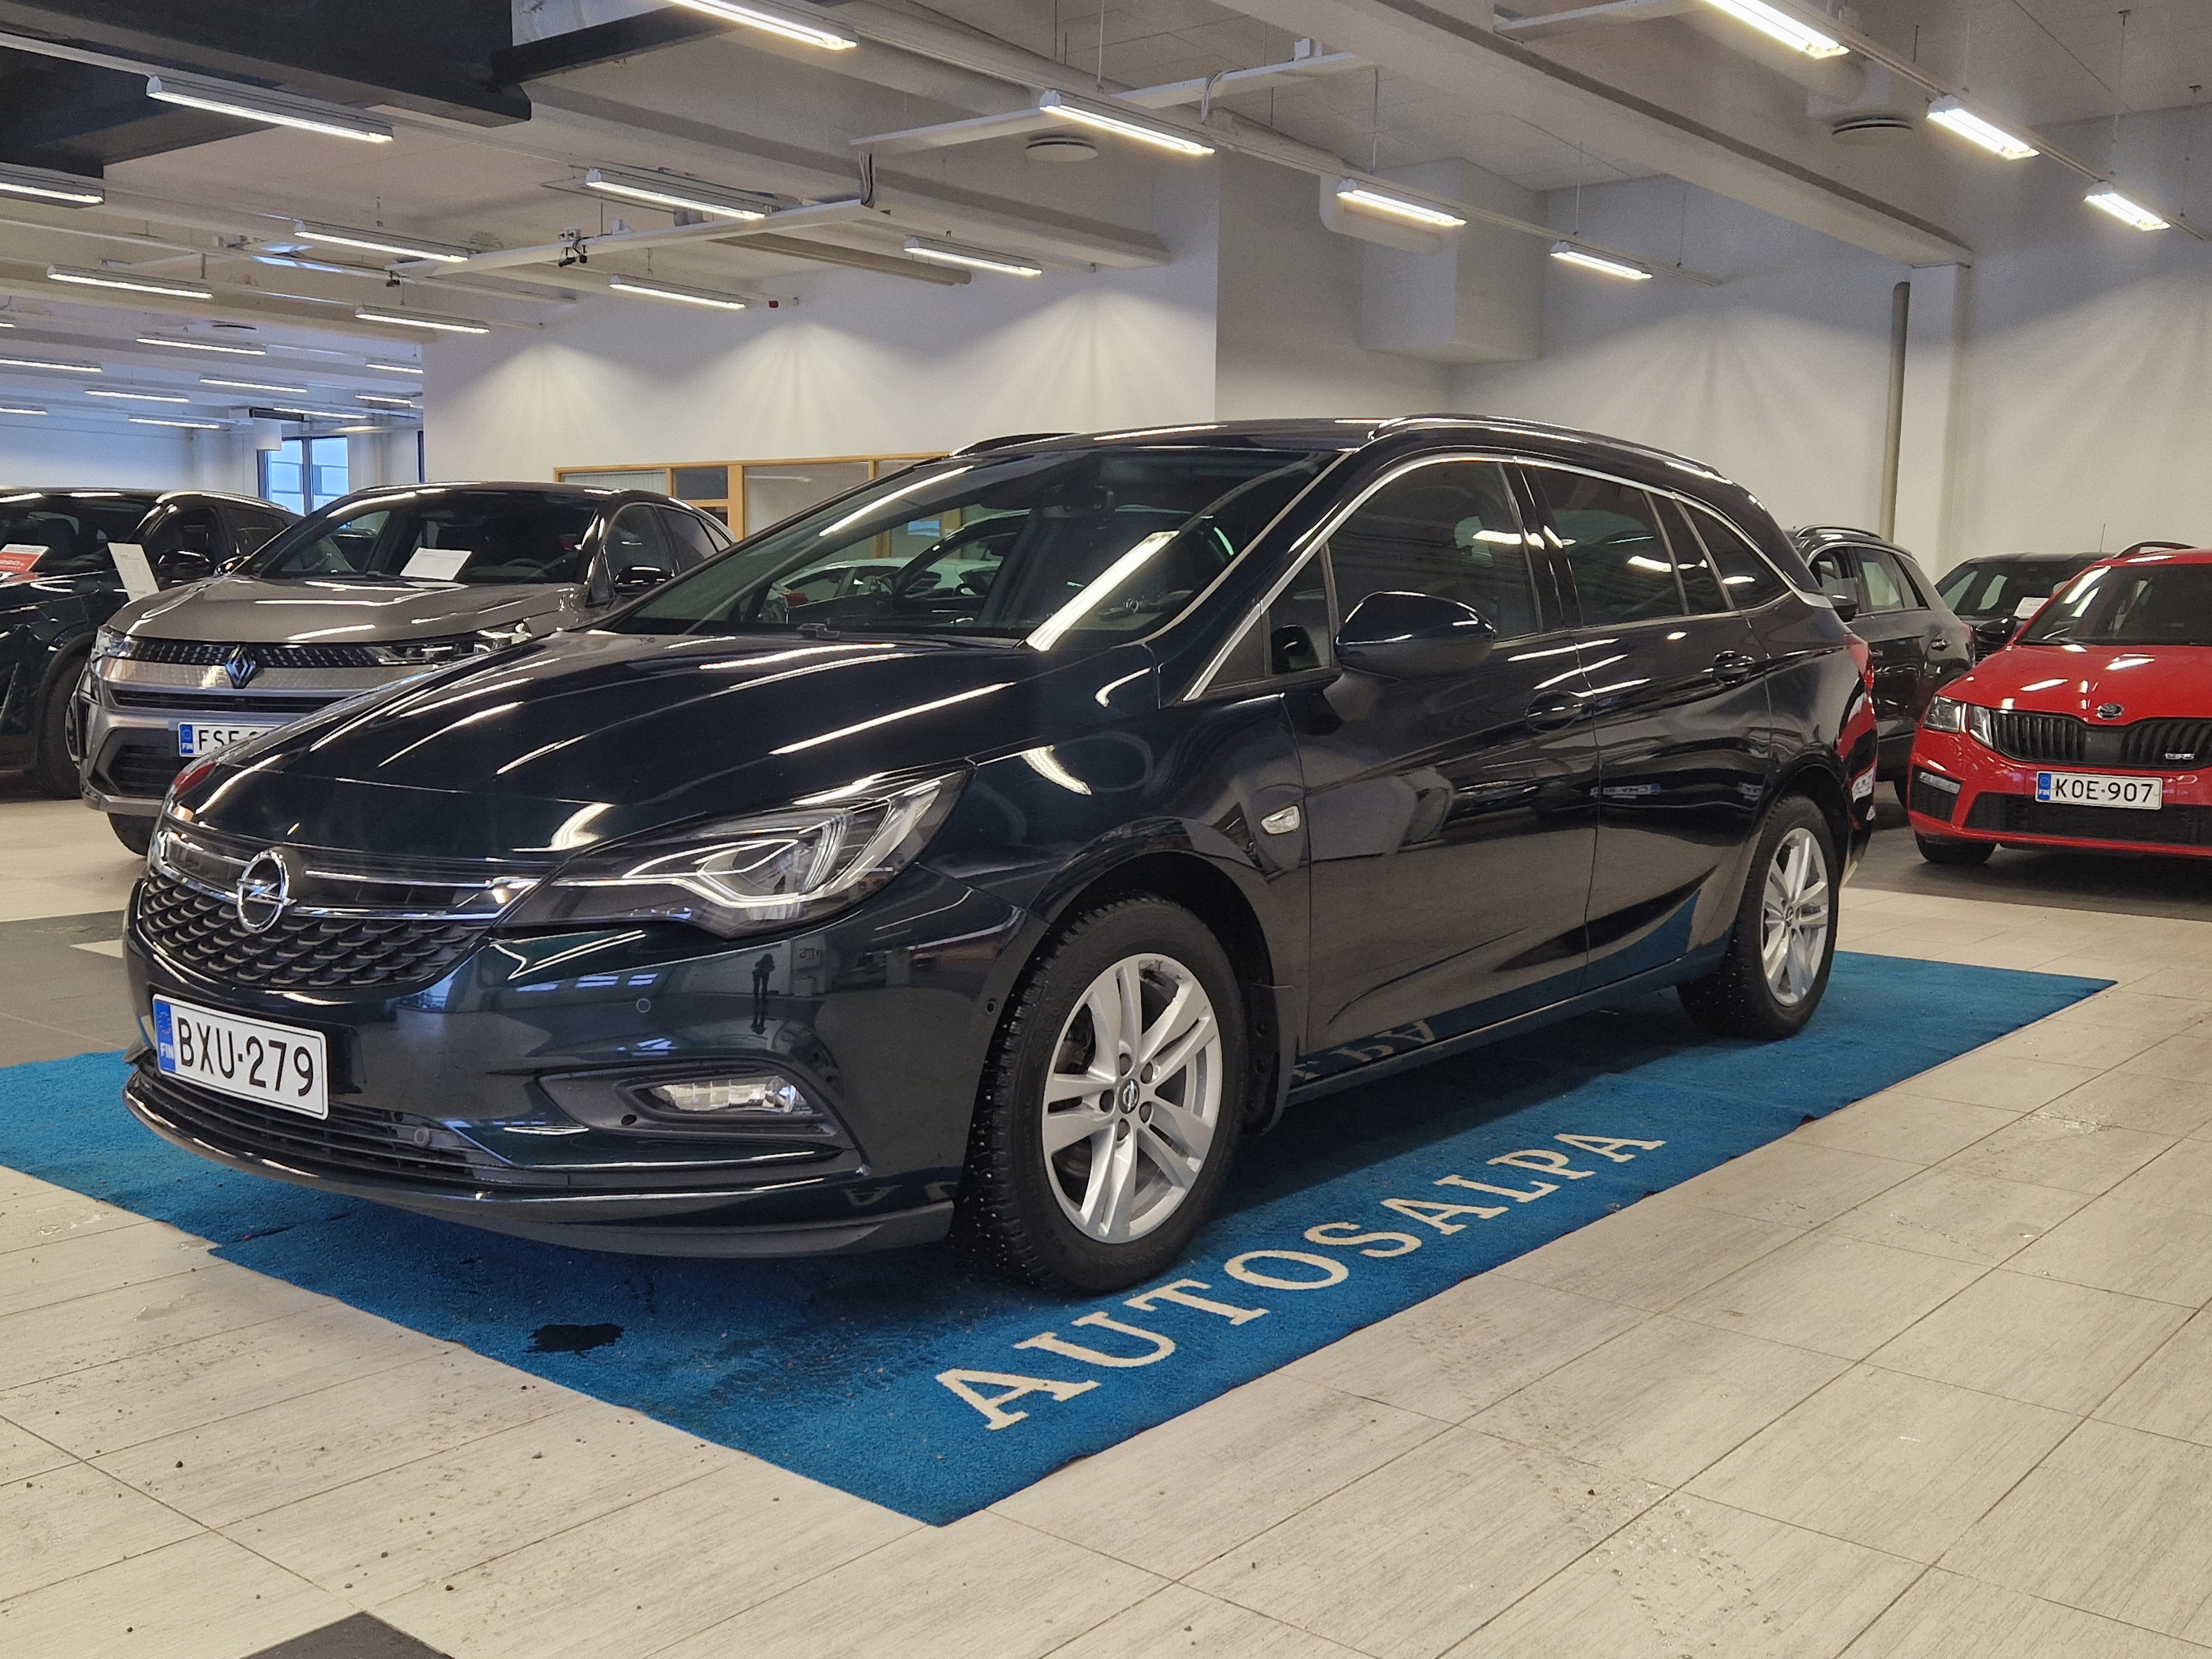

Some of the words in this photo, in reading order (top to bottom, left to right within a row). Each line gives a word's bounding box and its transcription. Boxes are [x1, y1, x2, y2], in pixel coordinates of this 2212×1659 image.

[2055, 778, 2154, 803] KOE-907
[160, 1042, 175, 1060] FIN
[178, 1016, 314, 1097] BXU-279
[935, 1131, 1667, 1431] AUTOSALPA
